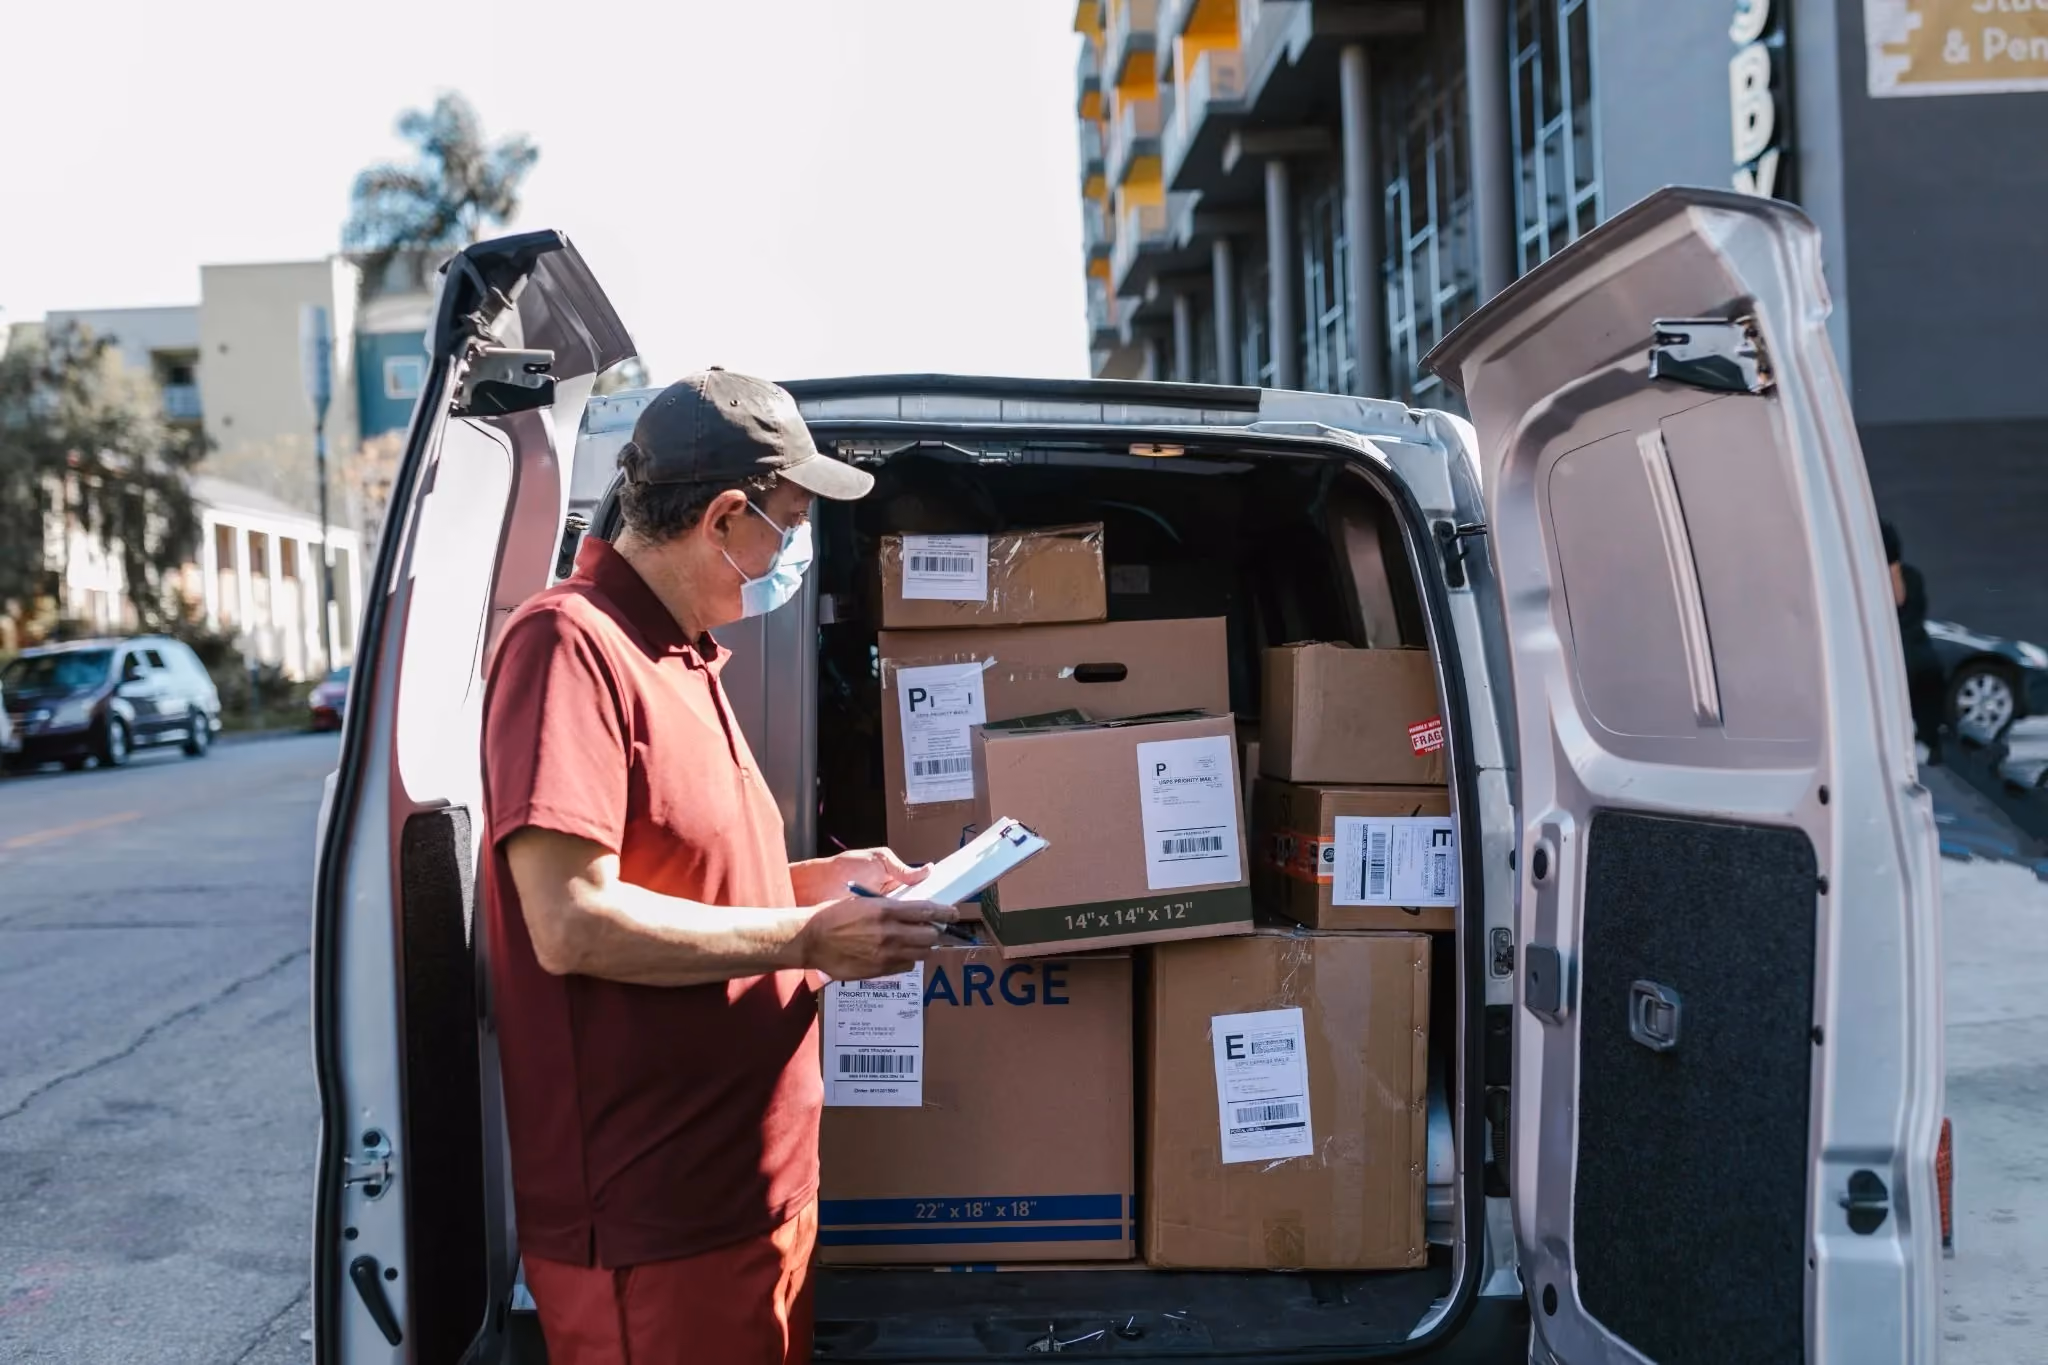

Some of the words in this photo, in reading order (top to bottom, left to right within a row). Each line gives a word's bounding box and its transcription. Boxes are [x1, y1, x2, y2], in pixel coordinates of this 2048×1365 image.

[1944, 29, 1970, 63] &
[908, 688, 927, 712] P
[1413, 730, 1443, 748] FRAG
[1156, 763, 1167, 776] P
[1432, 829, 1453, 847] E
[1065, 912, 1095, 930] 14"
[1098, 914, 1110, 928] x
[1115, 907, 1145, 925] 14"
[1148, 908, 1159, 923] x
[1164, 902, 1194, 920] 12"
[923, 964, 1070, 1007] ARGE
[1225, 1034, 1246, 1060] E
[916, 1203, 944, 1218] 22"
[950, 1208, 959, 1218] x
[965, 1202, 991, 1217] 18"
[996, 1206, 1006, 1216] x
[1011, 1201, 1037, 1216] 18"
